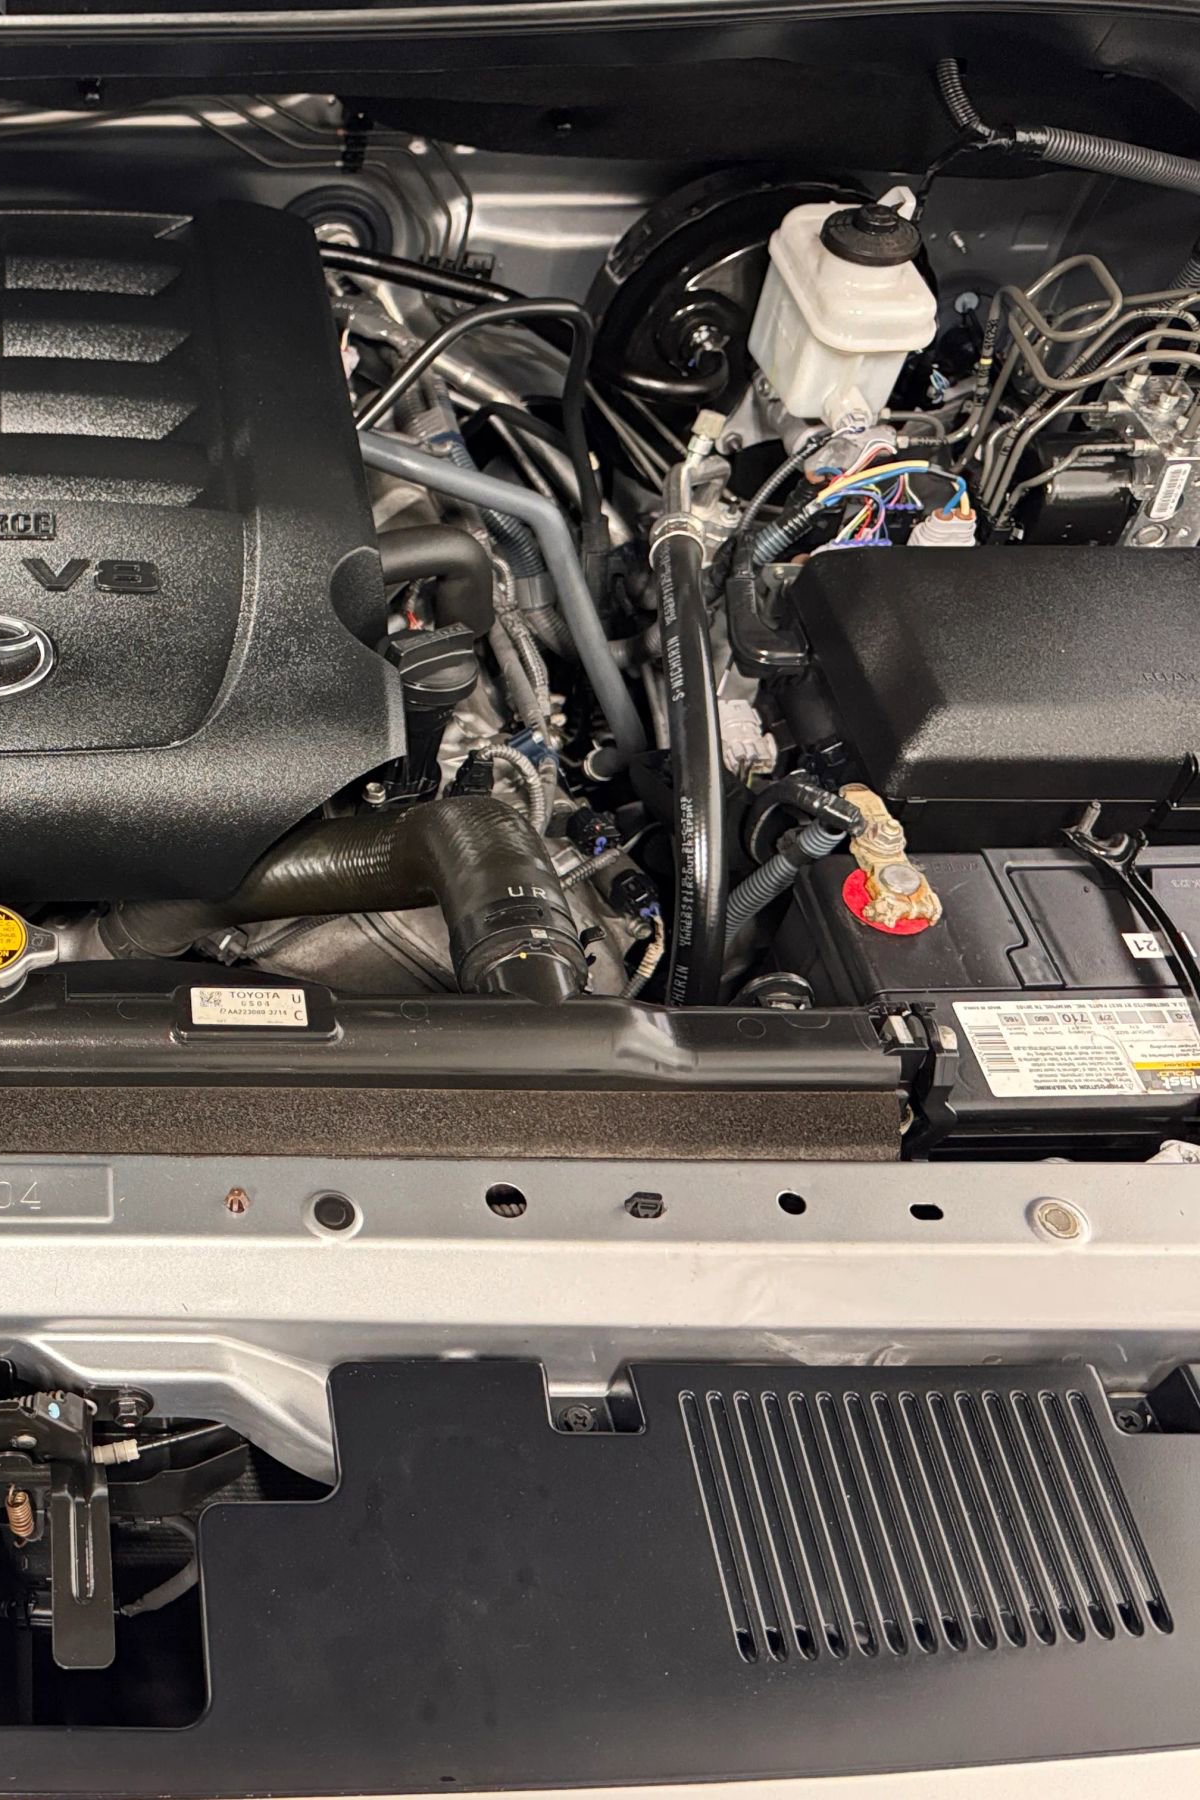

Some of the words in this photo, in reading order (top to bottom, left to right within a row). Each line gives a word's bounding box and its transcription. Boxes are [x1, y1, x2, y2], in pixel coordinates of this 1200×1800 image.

[22, 558, 160, 593] V8
[230, 991, 281, 999] TOYOTA
[291, 993, 302, 1004] U
[293, 1010, 304, 1021] C
[1062, 1013, 1088, 1023] 710
